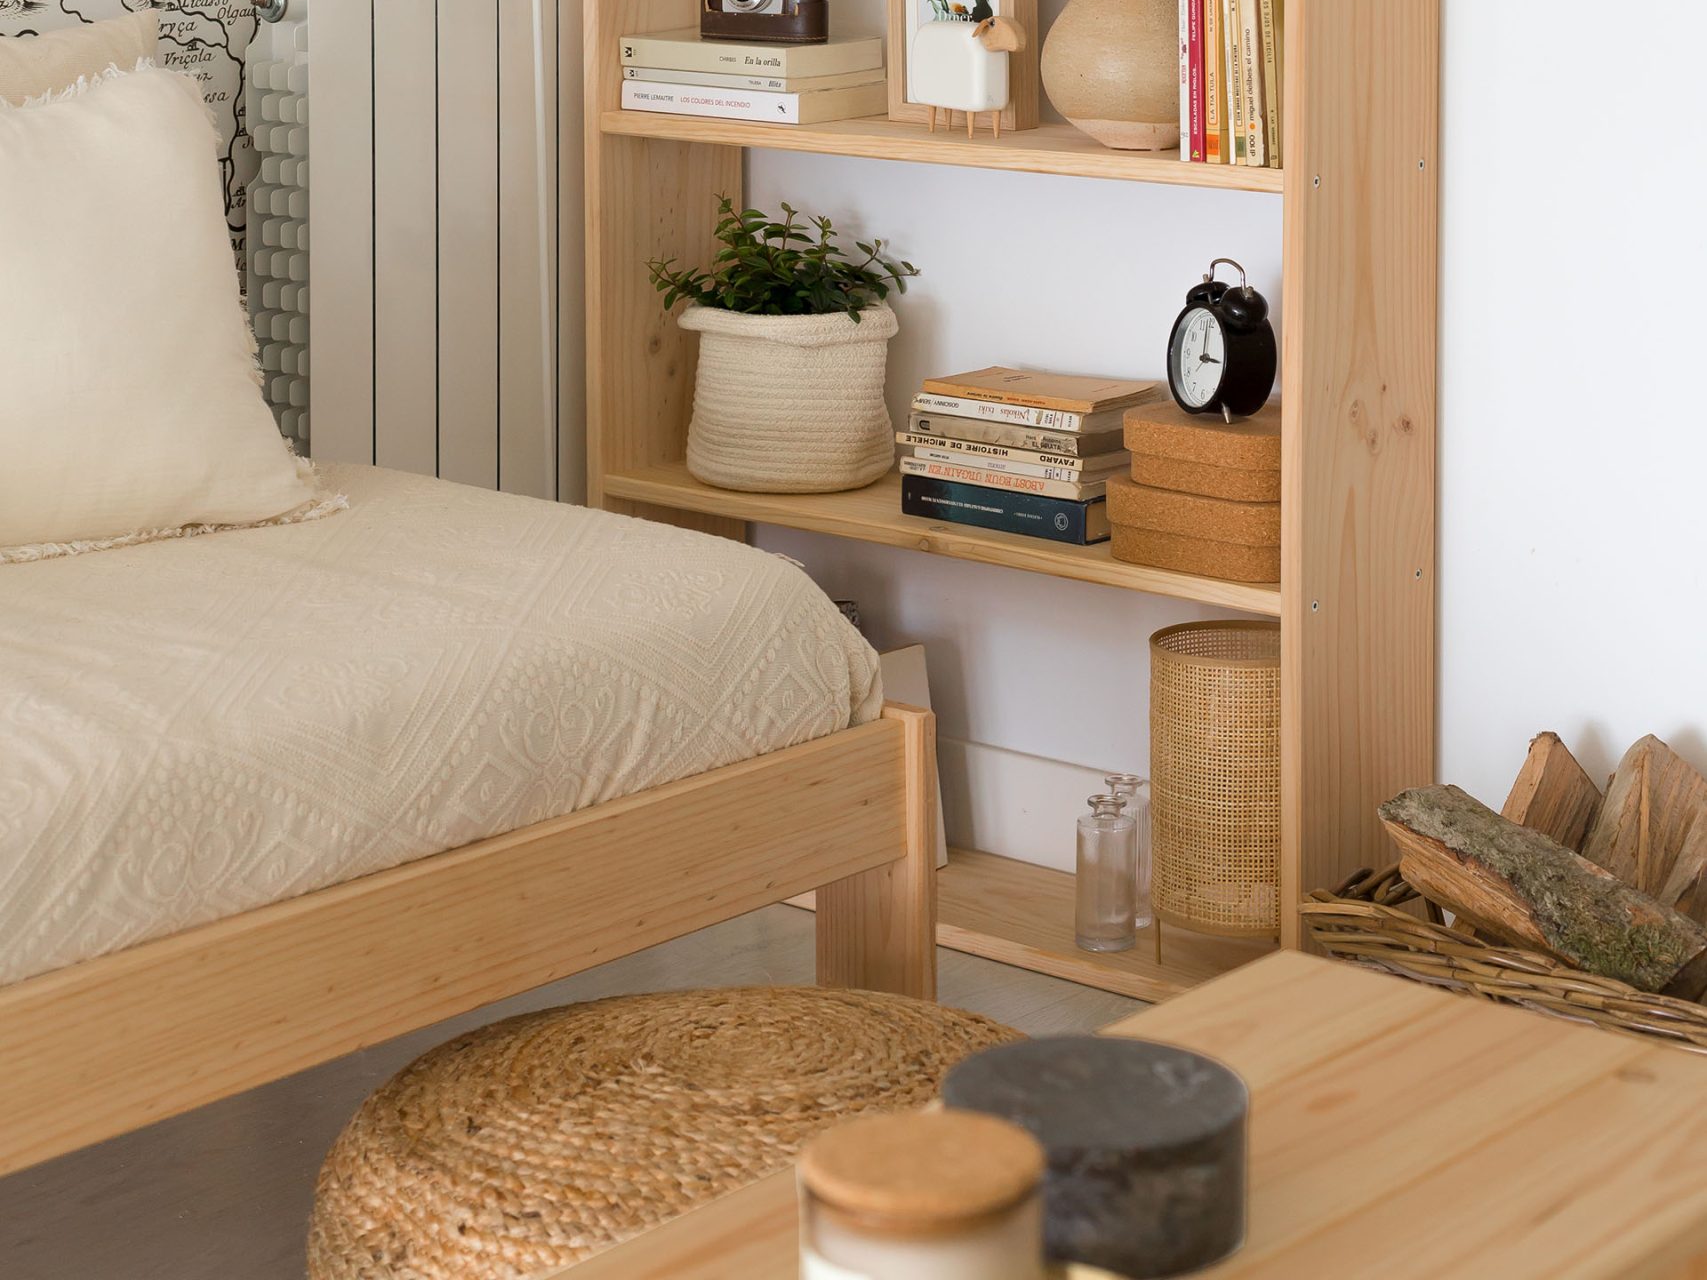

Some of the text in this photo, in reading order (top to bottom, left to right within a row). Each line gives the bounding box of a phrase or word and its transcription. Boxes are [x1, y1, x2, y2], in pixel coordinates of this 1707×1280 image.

[744, 56, 754, 65] En
[763, 58, 781, 67] orilla
[633, 92, 650, 100] PIERRE
[691, 98, 714, 106] COLORES
[715, 99, 725, 107] DEL
[725, 100, 751, 109] INCENDIO
[1247, 96, 1255, 122] miguel
[905, 435, 1075, 467] FAYARD HISTOIRE DE MICHELE
